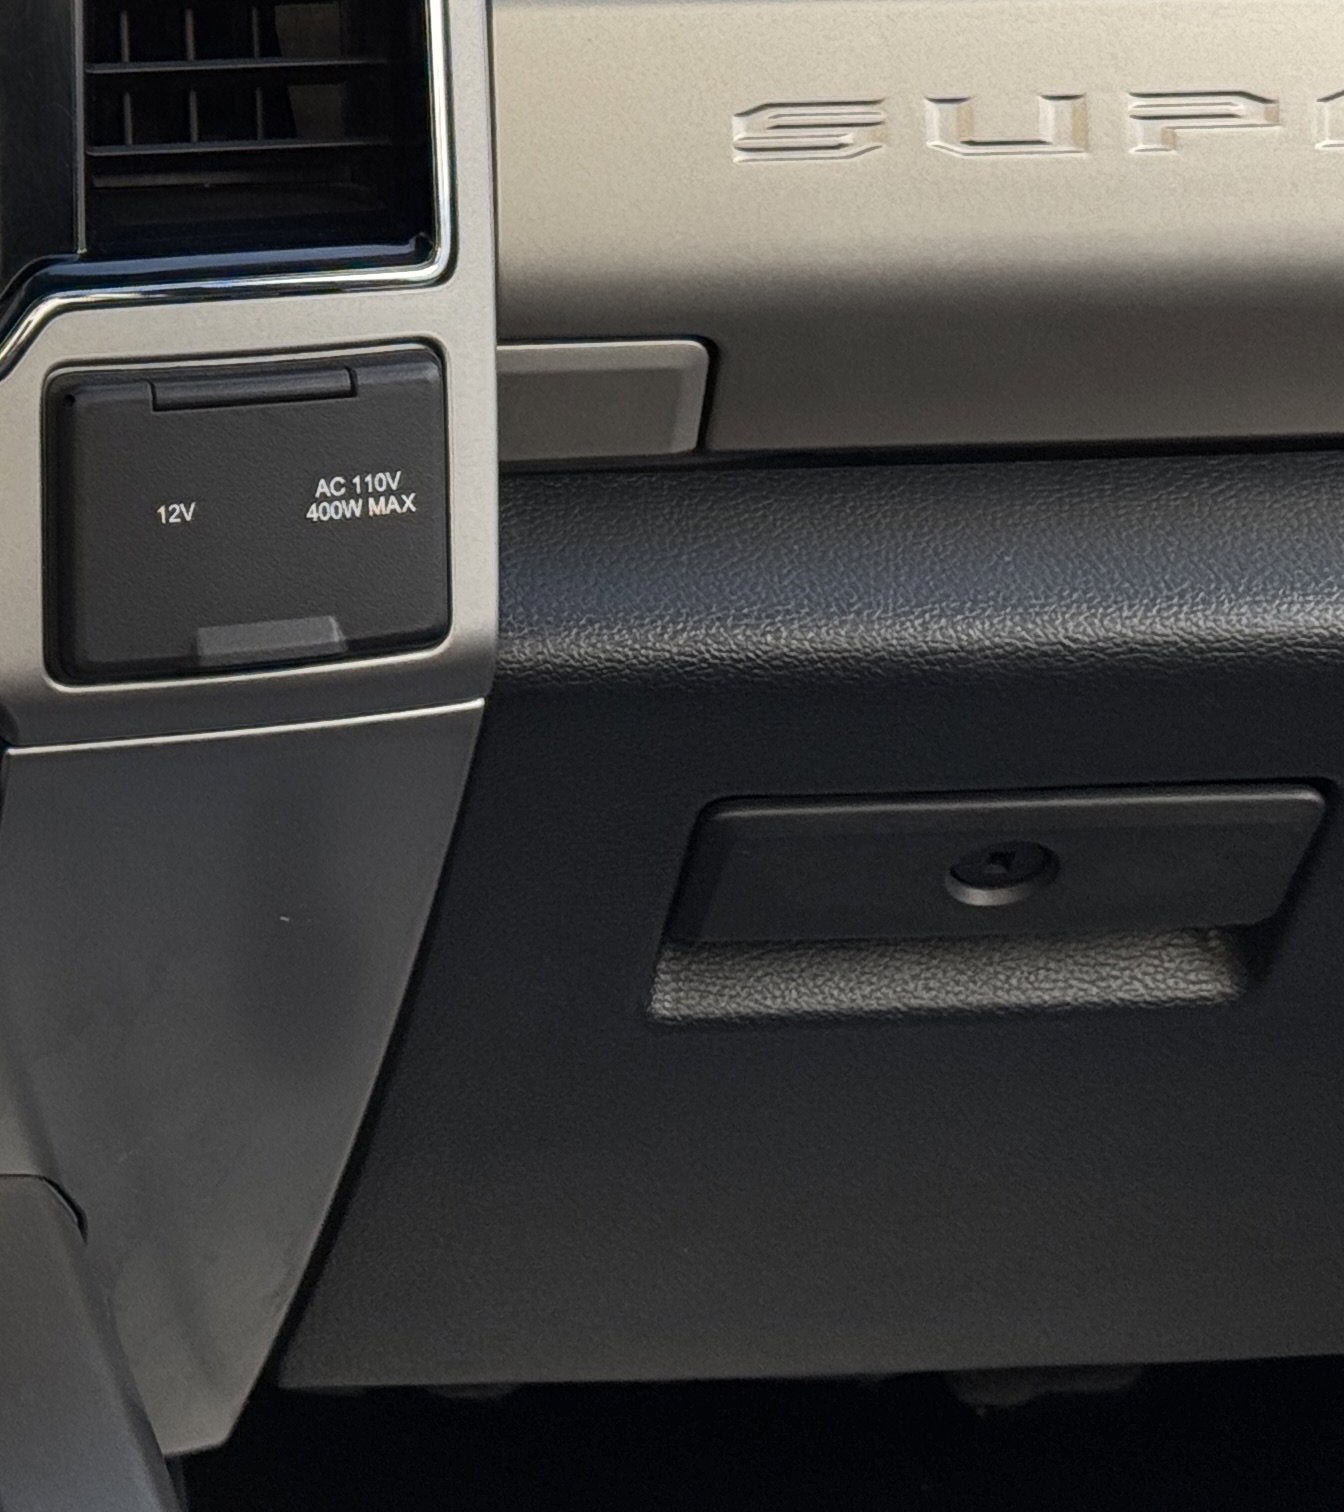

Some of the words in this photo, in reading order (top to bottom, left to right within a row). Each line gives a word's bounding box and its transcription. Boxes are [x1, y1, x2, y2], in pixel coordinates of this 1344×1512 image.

[732, 90, 1344, 164] SUP
[315, 476, 346, 498] AC
[352, 470, 402, 494] 110V
[156, 502, 196, 524] 12V
[306, 498, 363, 522] 400W
[368, 492, 417, 516] MAX
